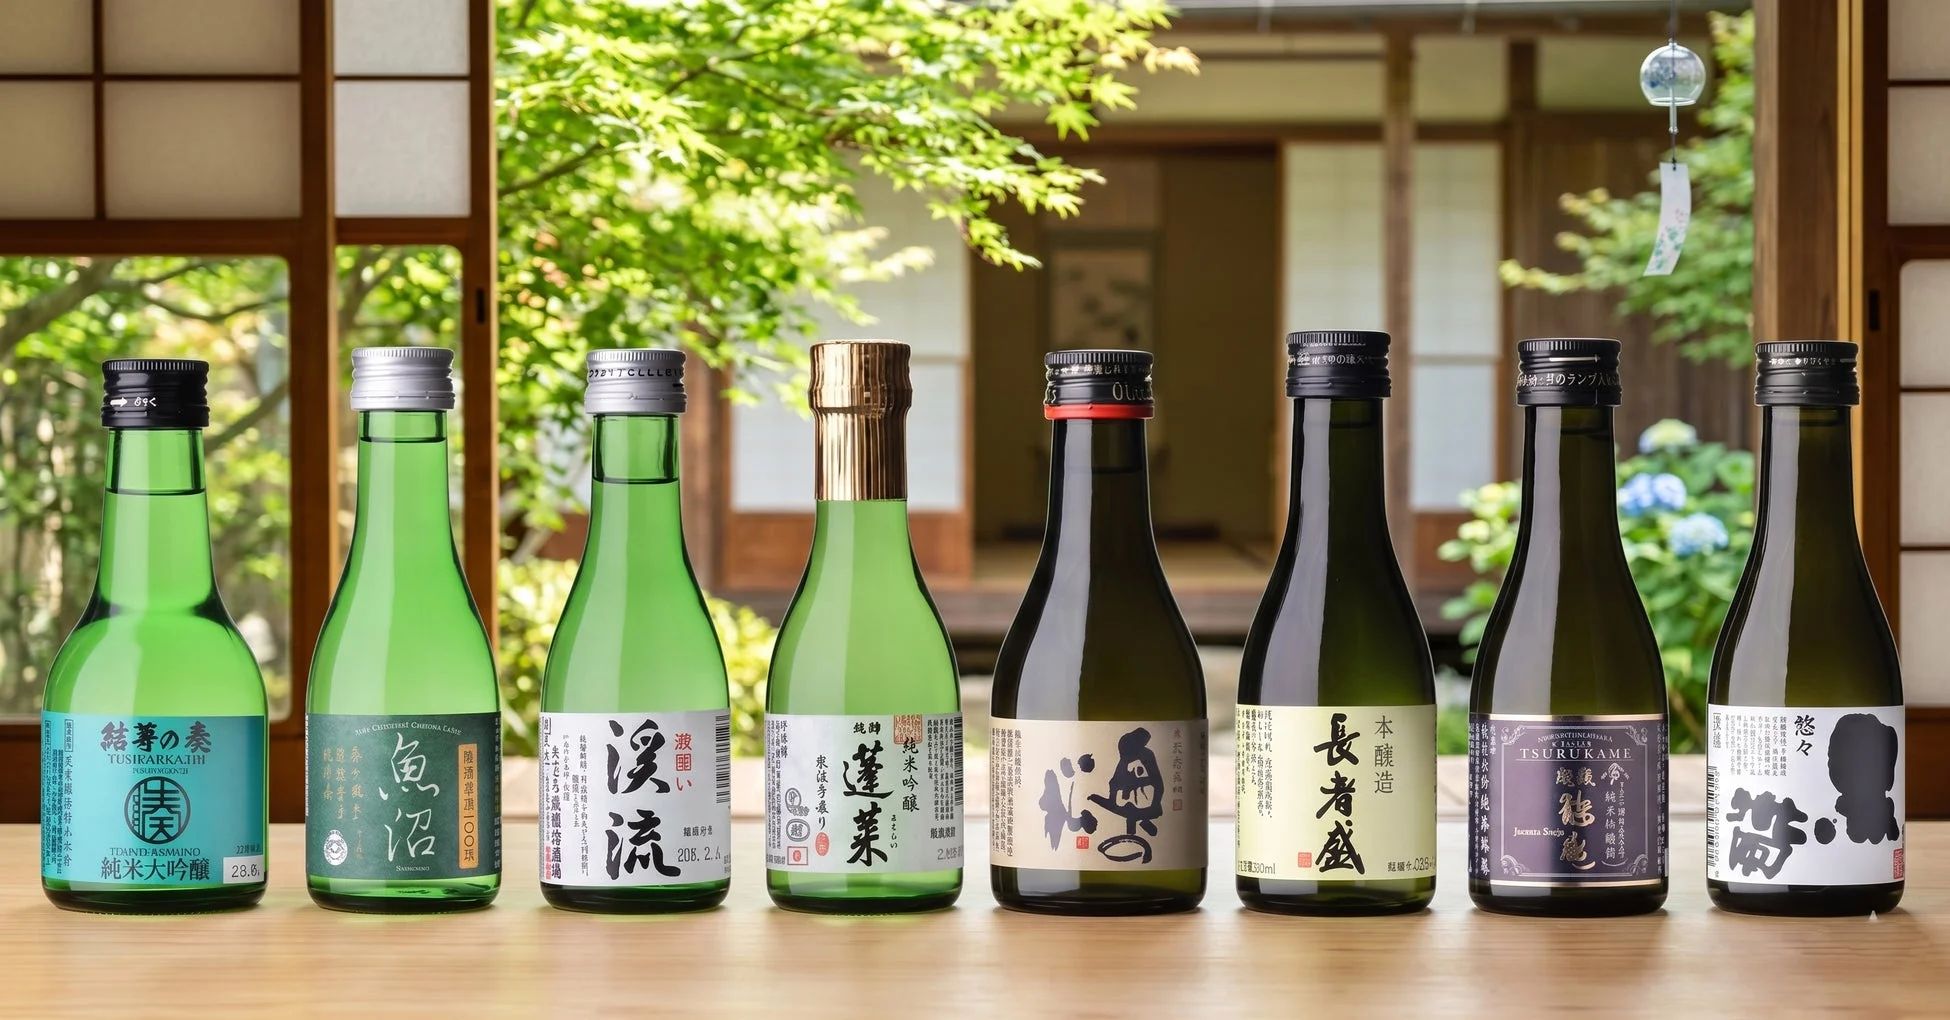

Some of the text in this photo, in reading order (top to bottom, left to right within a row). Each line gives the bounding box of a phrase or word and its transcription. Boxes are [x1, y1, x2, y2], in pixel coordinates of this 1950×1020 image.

[901, 736, 920, 813] 純米吟醸
[1374, 715, 1394, 794] 本醸造
[1519, 748, 1632, 760] TSURUKAME
[1794, 714, 1816, 757] 悠々
[378, 732, 440, 862] 魚沼
[605, 718, 682, 881] 渓流
[842, 739, 894, 867] 蓬莱
[1312, 712, 1366, 875] 長者盛
[100, 857, 210, 881] 純米大吟醸
